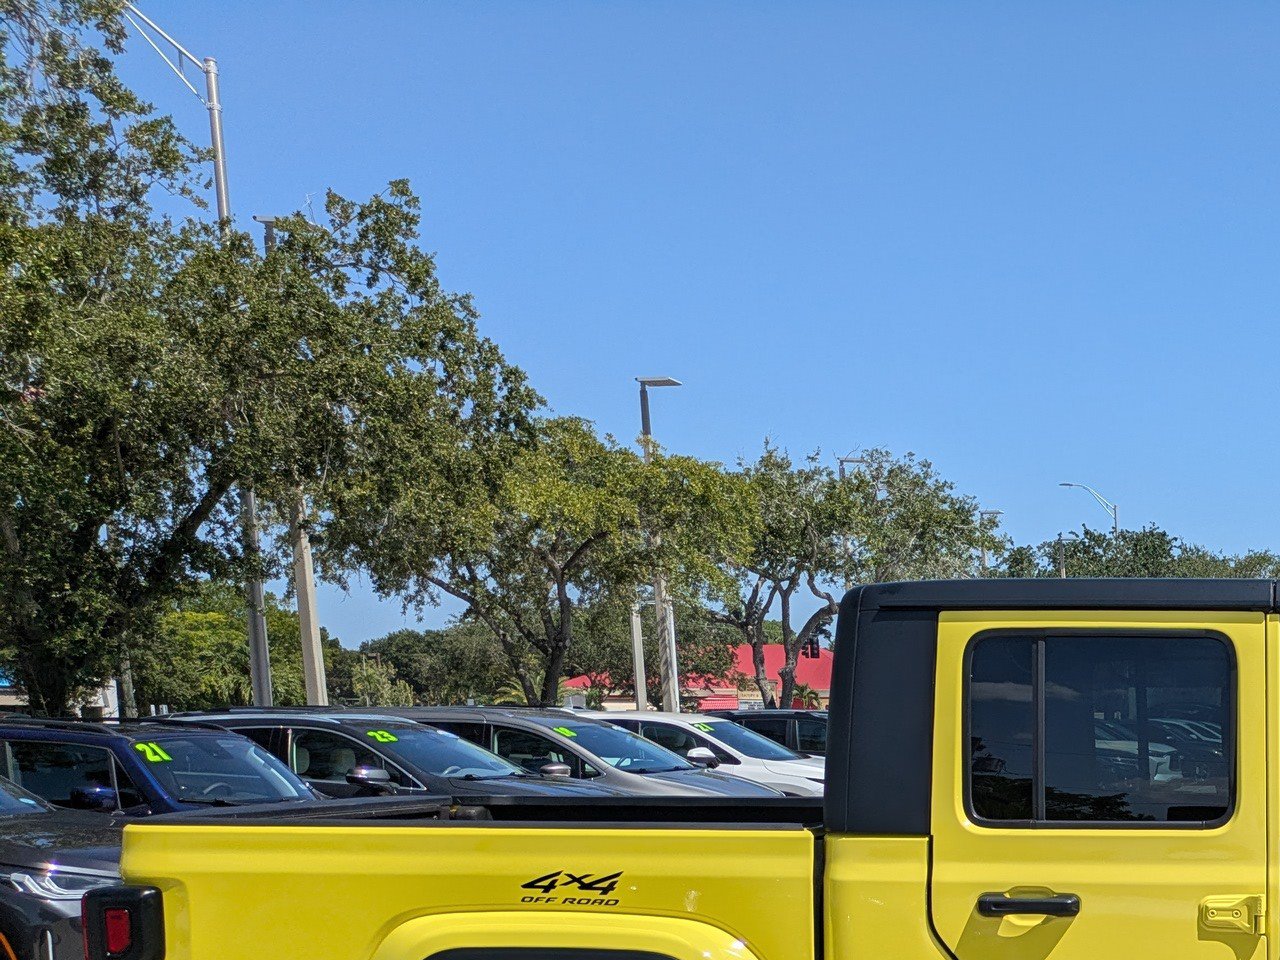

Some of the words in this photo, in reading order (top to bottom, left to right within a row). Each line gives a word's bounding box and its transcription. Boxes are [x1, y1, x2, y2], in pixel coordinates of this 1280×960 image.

[366, 729, 399, 743] 23
[134, 741, 173, 763] 21
[520, 896, 557, 904] OFF
[561, 897, 620, 906] ROAD
